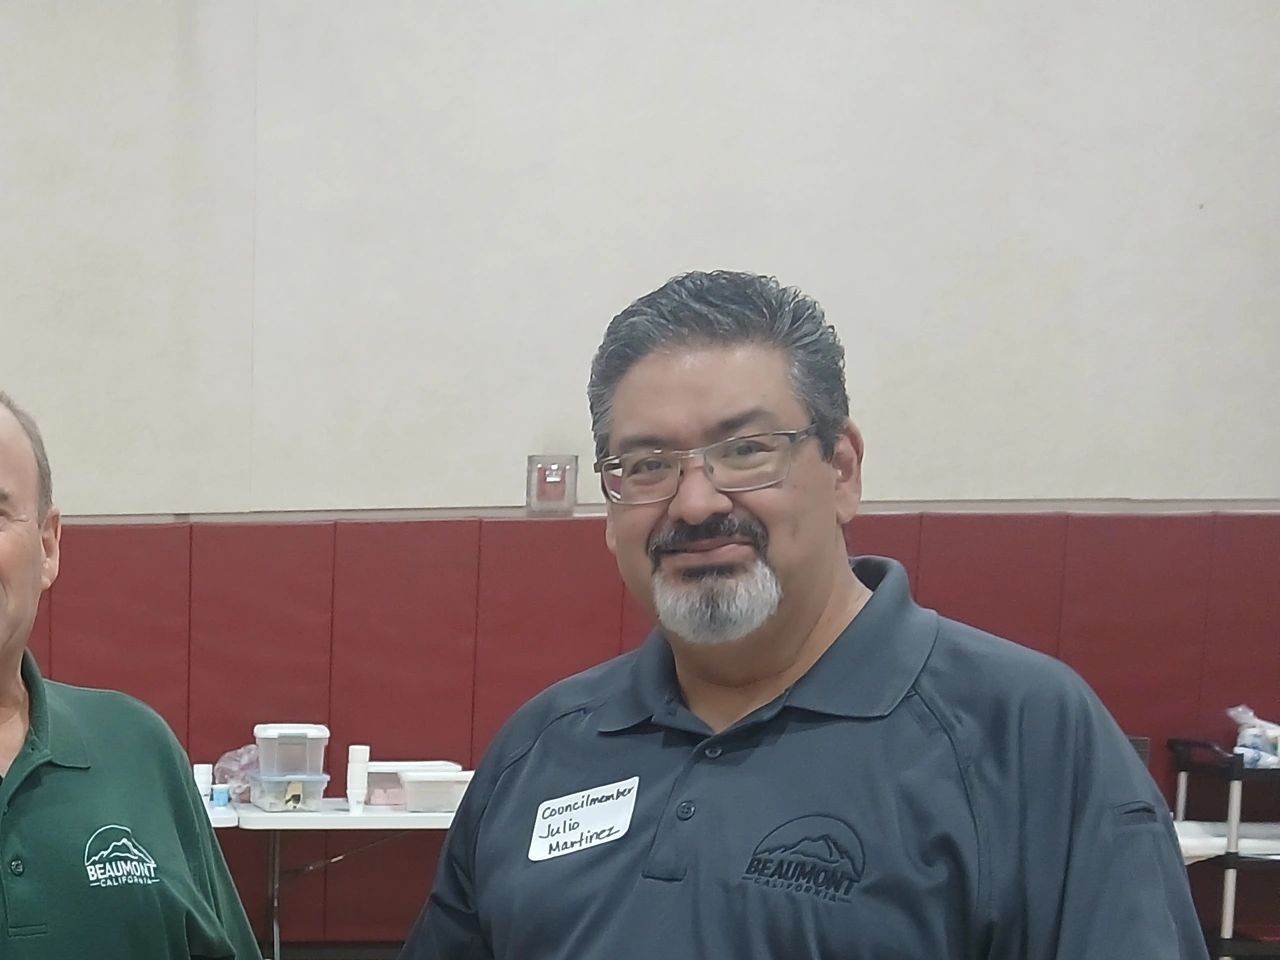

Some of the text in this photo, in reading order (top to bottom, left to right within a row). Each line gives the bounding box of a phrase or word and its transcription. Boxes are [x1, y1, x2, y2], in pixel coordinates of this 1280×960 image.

[541, 785, 635, 820] Councilmember
[538, 818, 580, 839] Julio
[548, 825, 620, 855] Martinez
[86, 860, 157, 881] BEAUMONT
[100, 875, 152, 887] CALIFORNIA
[745, 856, 861, 896] BEAUMONT
[754, 878, 837, 903] CALIFORNIA
